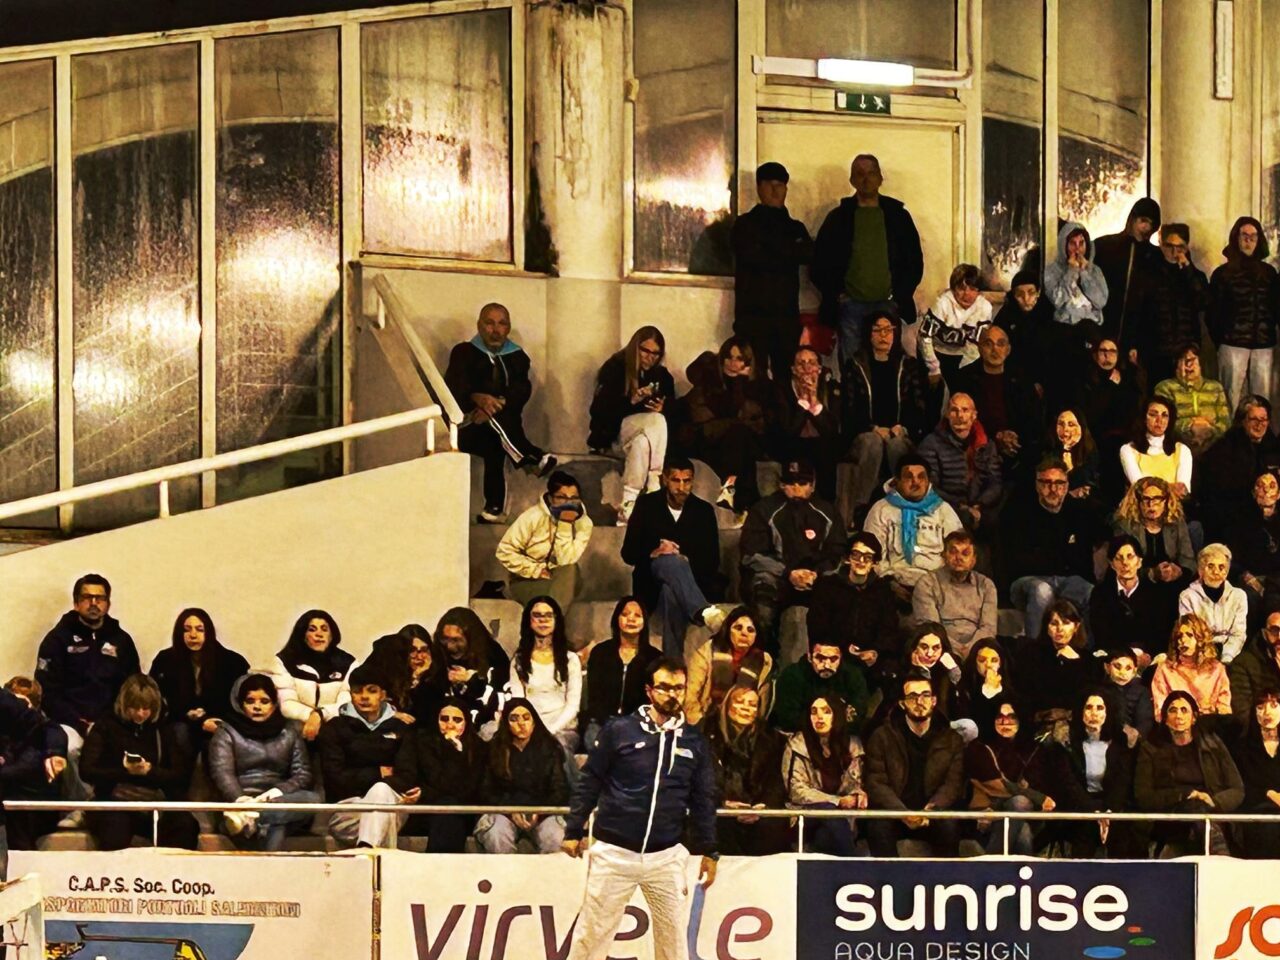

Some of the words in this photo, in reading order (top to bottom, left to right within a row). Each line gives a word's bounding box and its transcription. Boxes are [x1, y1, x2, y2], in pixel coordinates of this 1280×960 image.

[133, 878, 167, 893] Soc.
[171, 879, 215, 896] Coop.
[835, 866, 1129, 932] sunrise
[926, 942, 1031, 960] DESIGN
